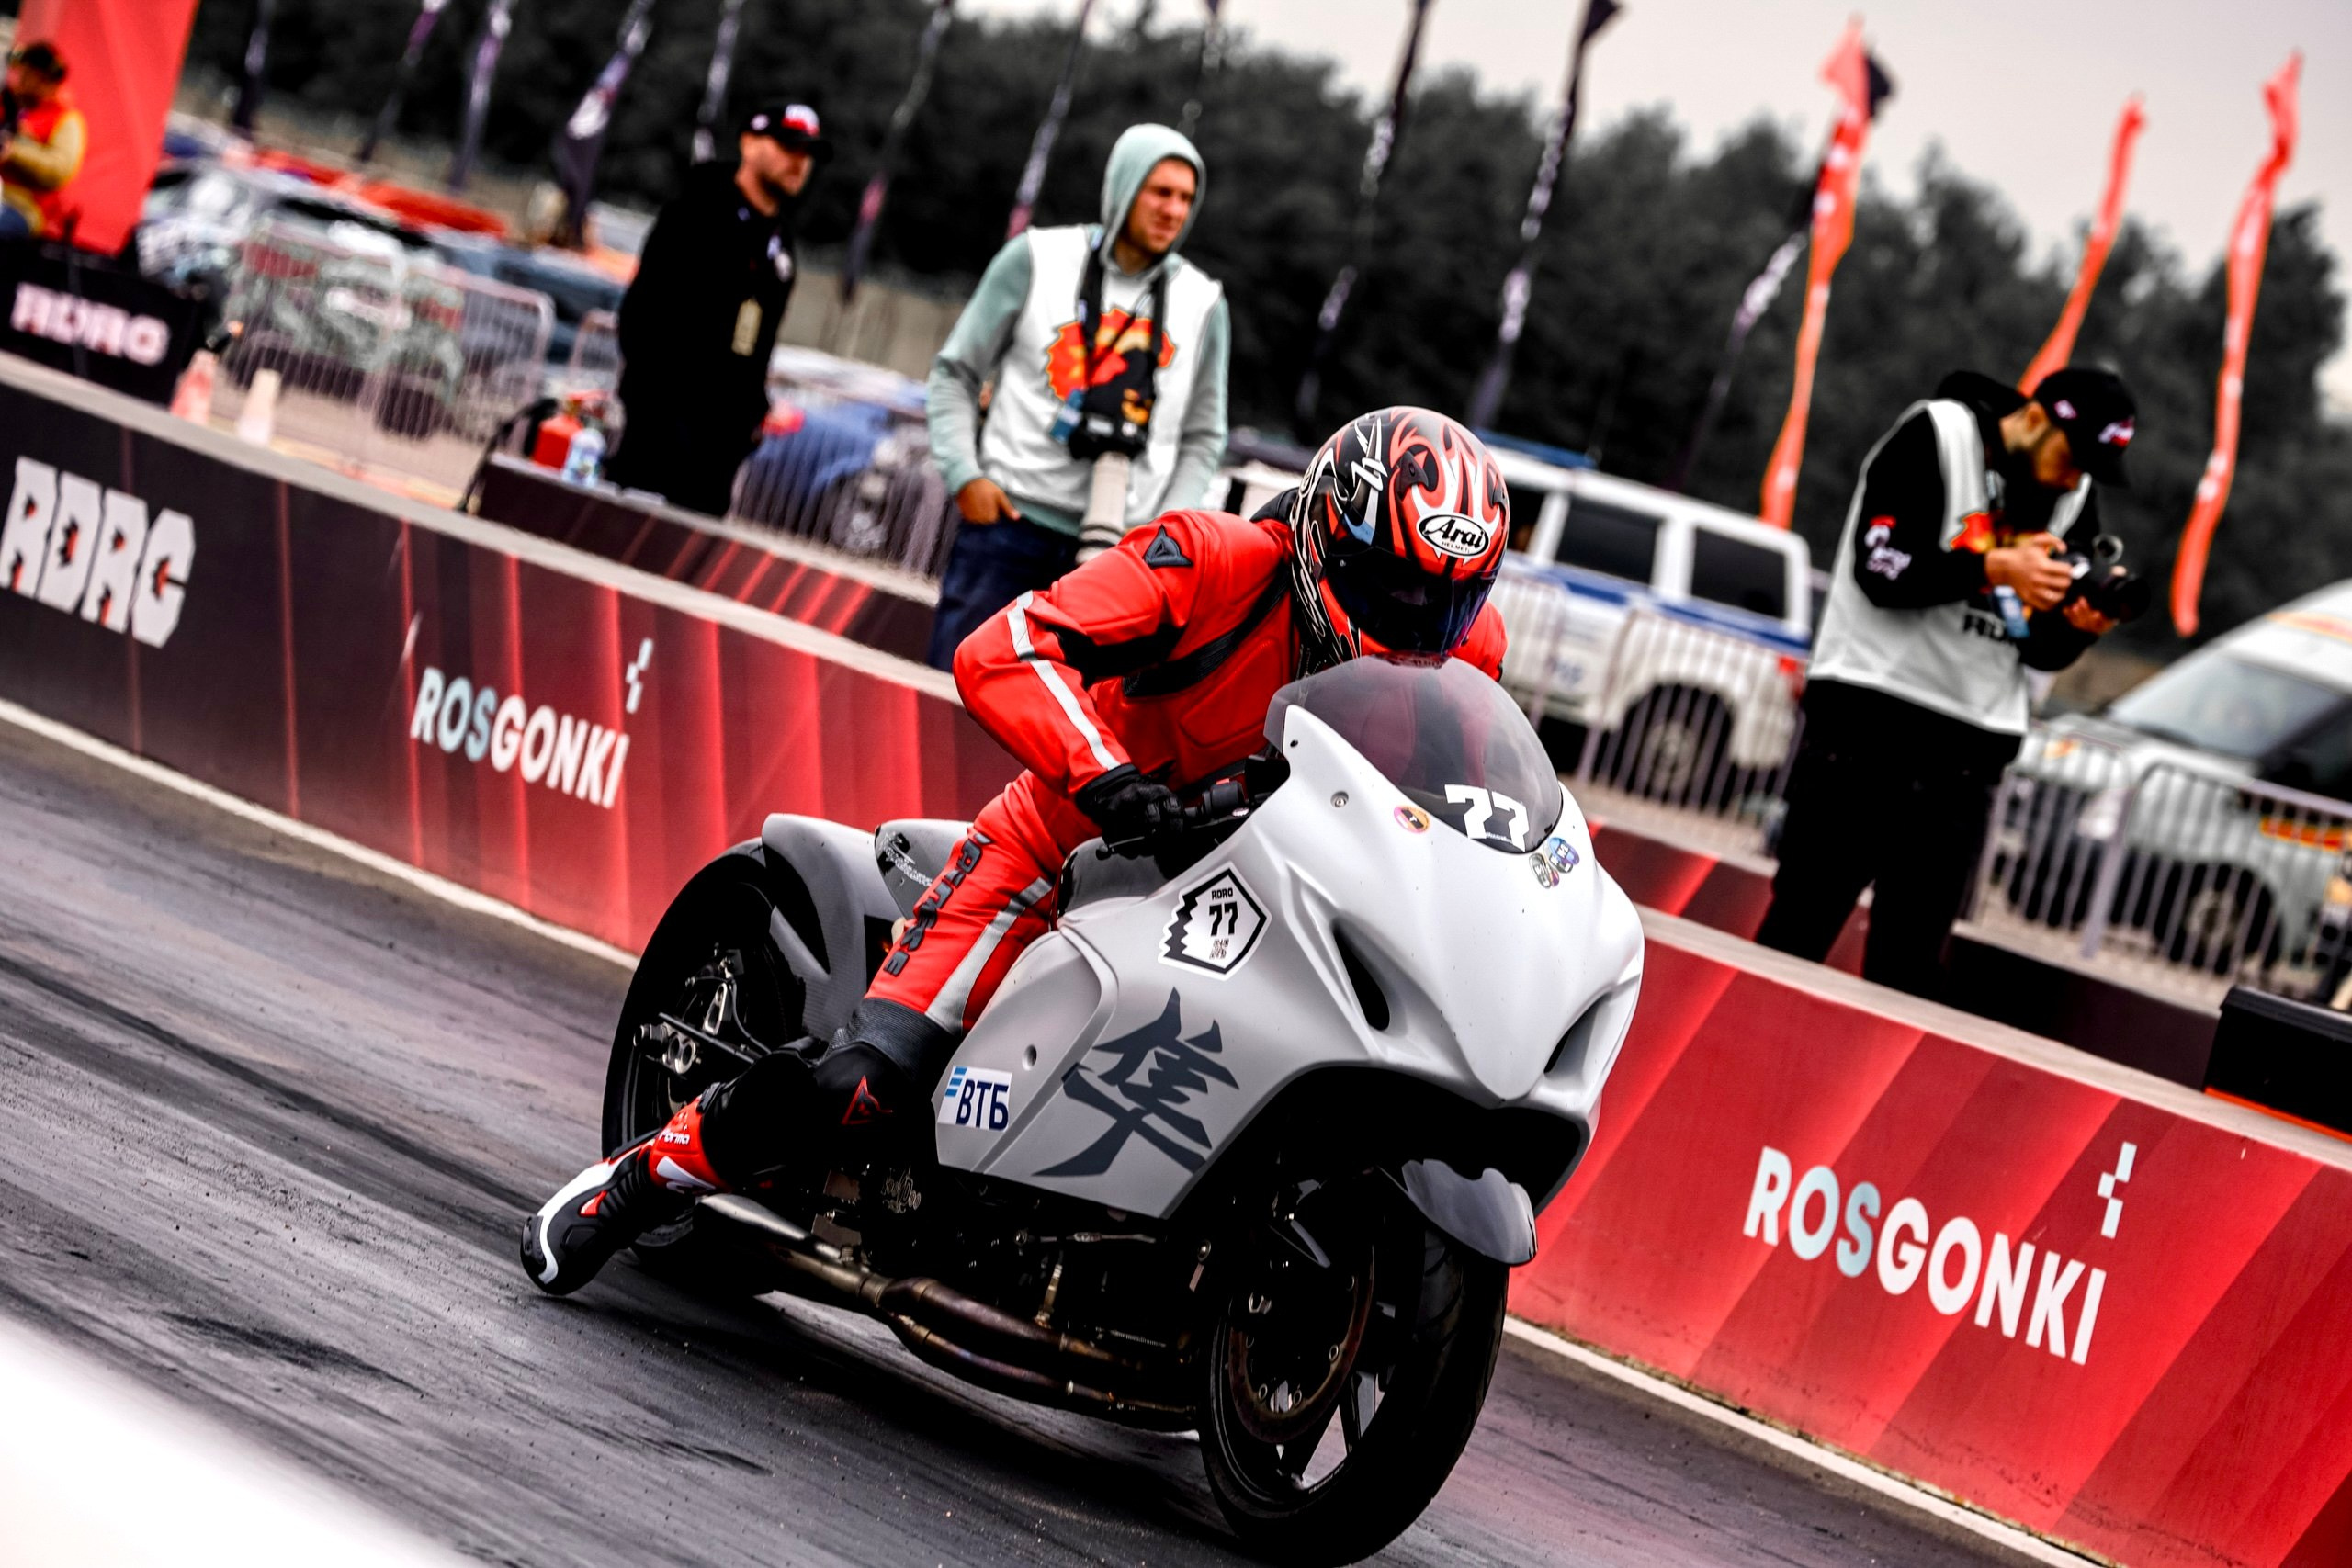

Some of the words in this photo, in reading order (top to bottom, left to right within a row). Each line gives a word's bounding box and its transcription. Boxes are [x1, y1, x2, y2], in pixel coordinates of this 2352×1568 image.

[0, 456, 196, 649] RDRC
[1422, 518, 1485, 548] Arai
[410, 666, 630, 809] ROSGONKI
[1444, 784, 1530, 852] 77
[1209, 901, 1238, 937] 77
[956, 1078, 1009, 1131] ВТБ
[1031, 986, 1240, 1177] 隼
[1743, 1146, 2107, 1365] ROSGONKI
